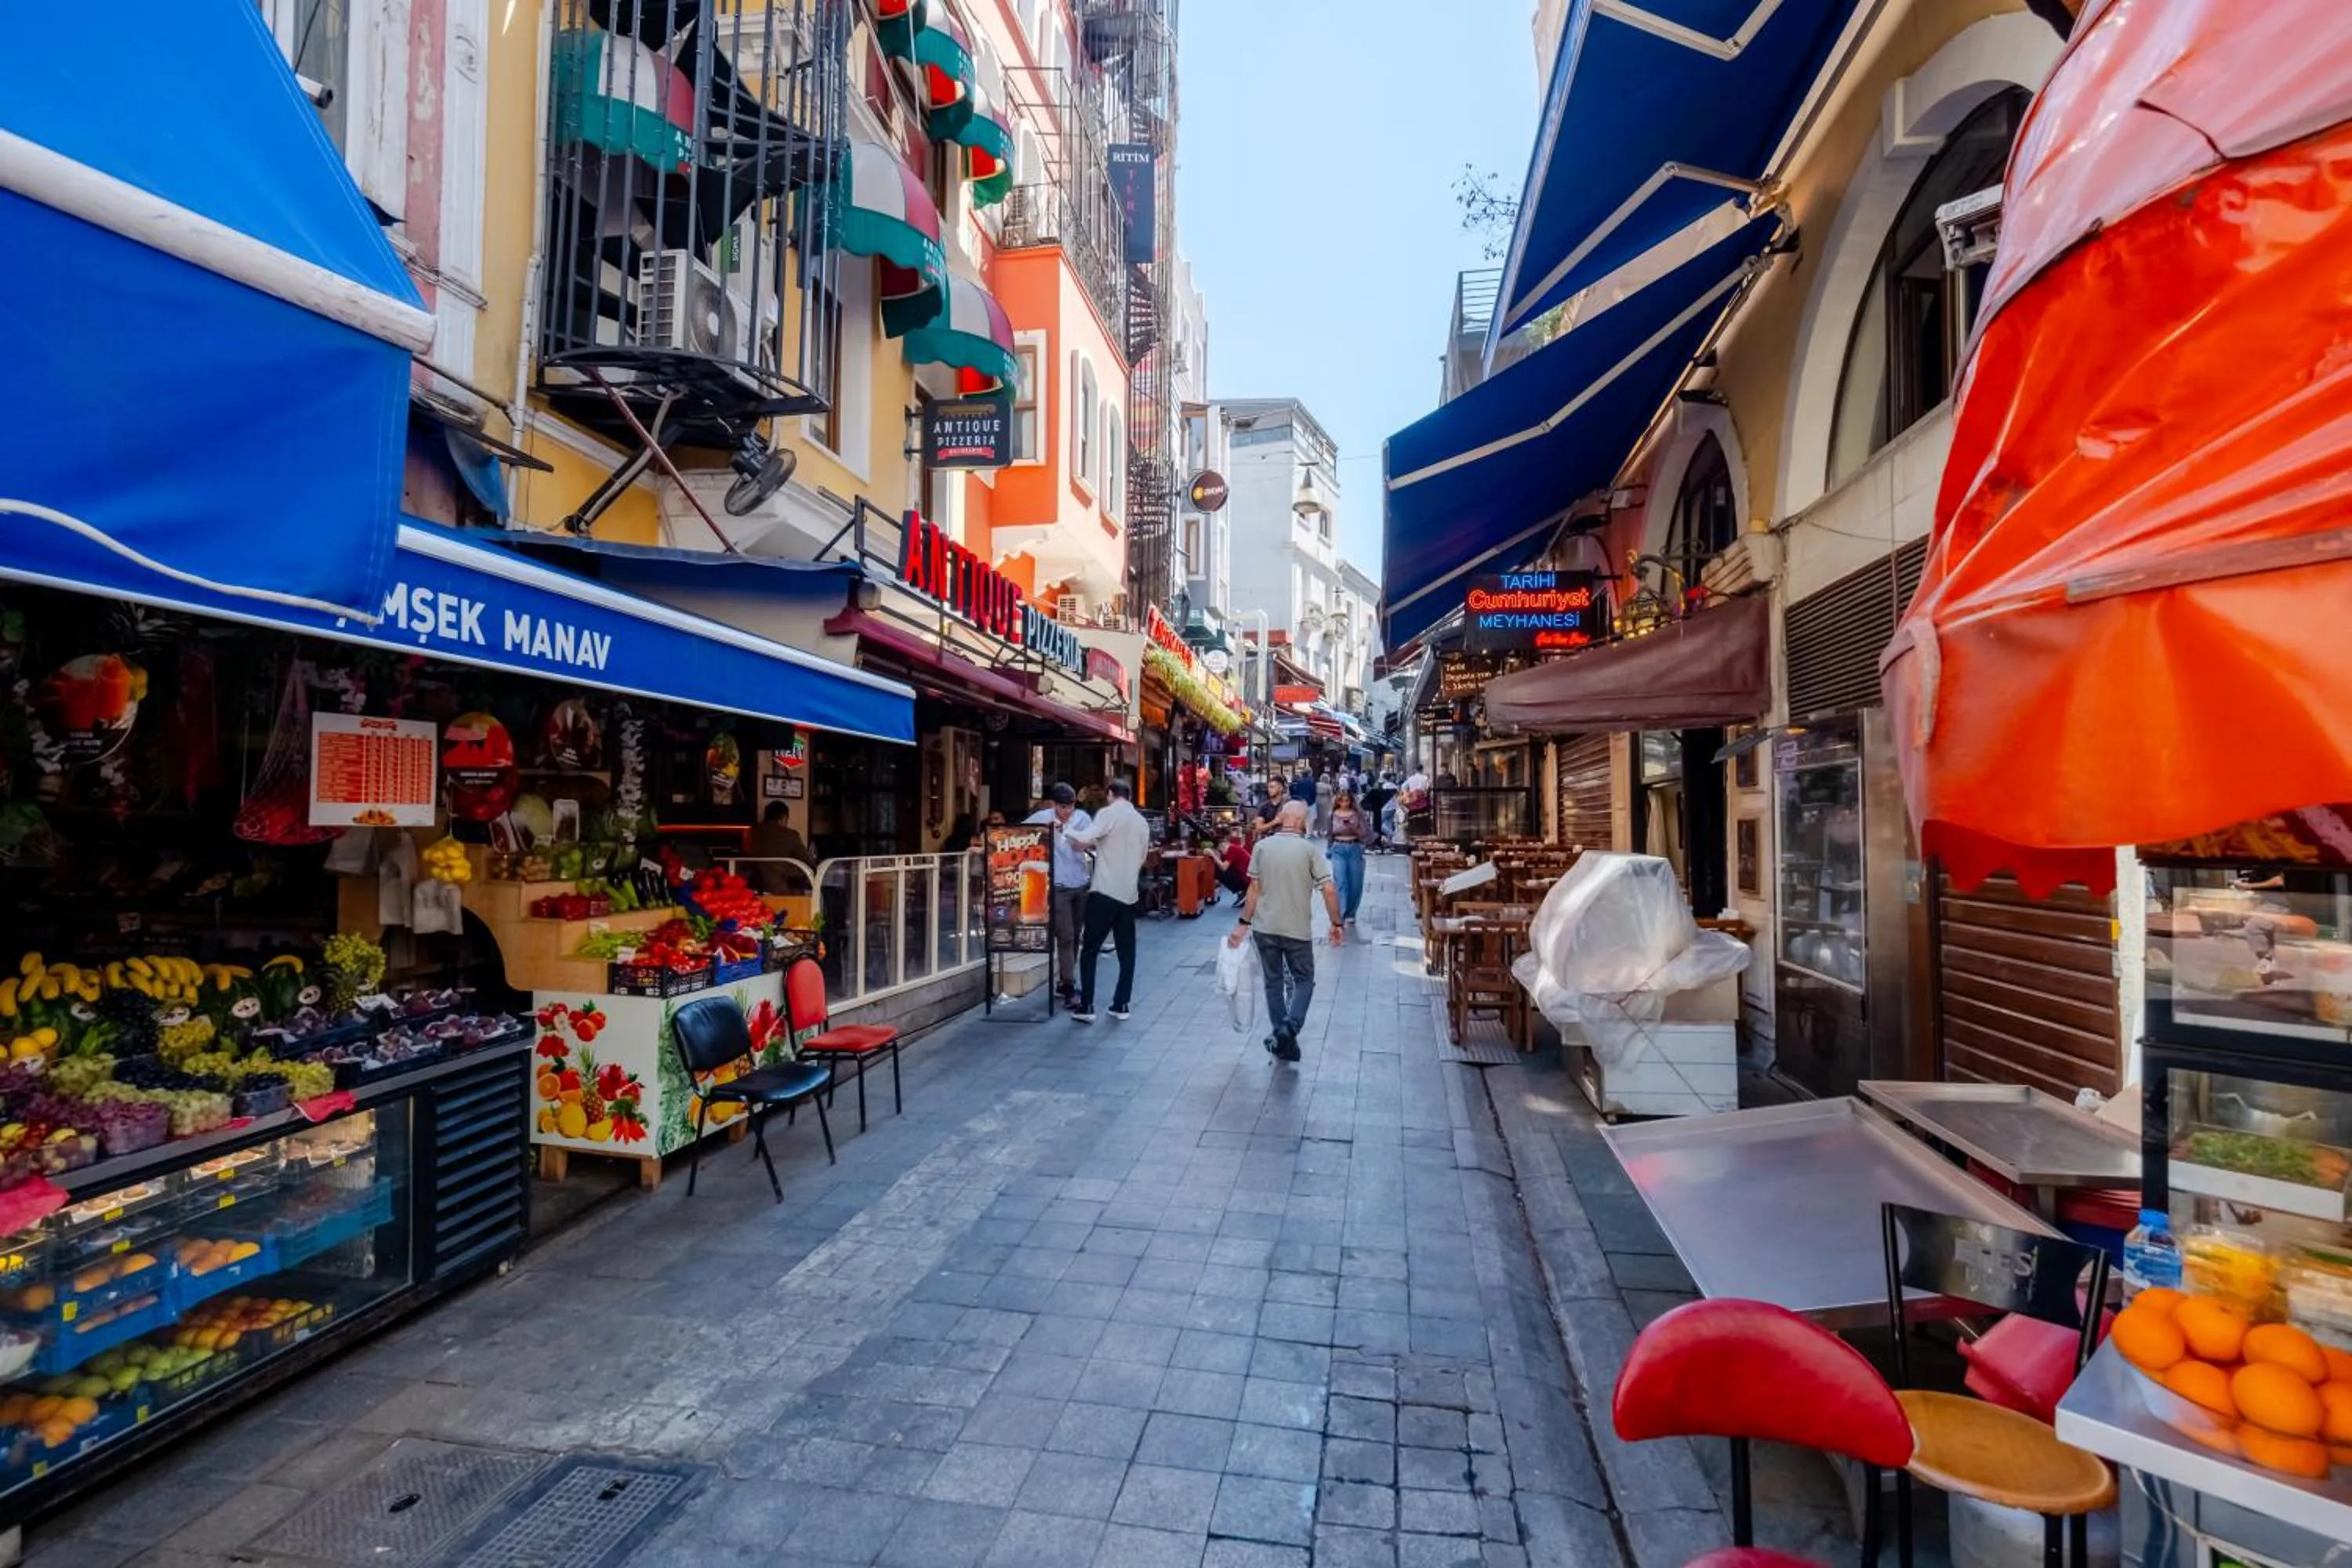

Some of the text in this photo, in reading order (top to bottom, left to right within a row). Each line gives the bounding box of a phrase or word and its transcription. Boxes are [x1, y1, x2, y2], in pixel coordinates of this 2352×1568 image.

[933, 419, 1001, 434] ANTIQUE
[937, 435, 996, 447] PIZZERIA
[899, 509, 1023, 644] ANTIQUE
[1025, 603, 1084, 677] PIZZERIA
[1468, 586, 1590, 612] Cumhuriyet
[504, 609, 612, 671] MANAV
[996, 832, 1042, 853] HAPPY
